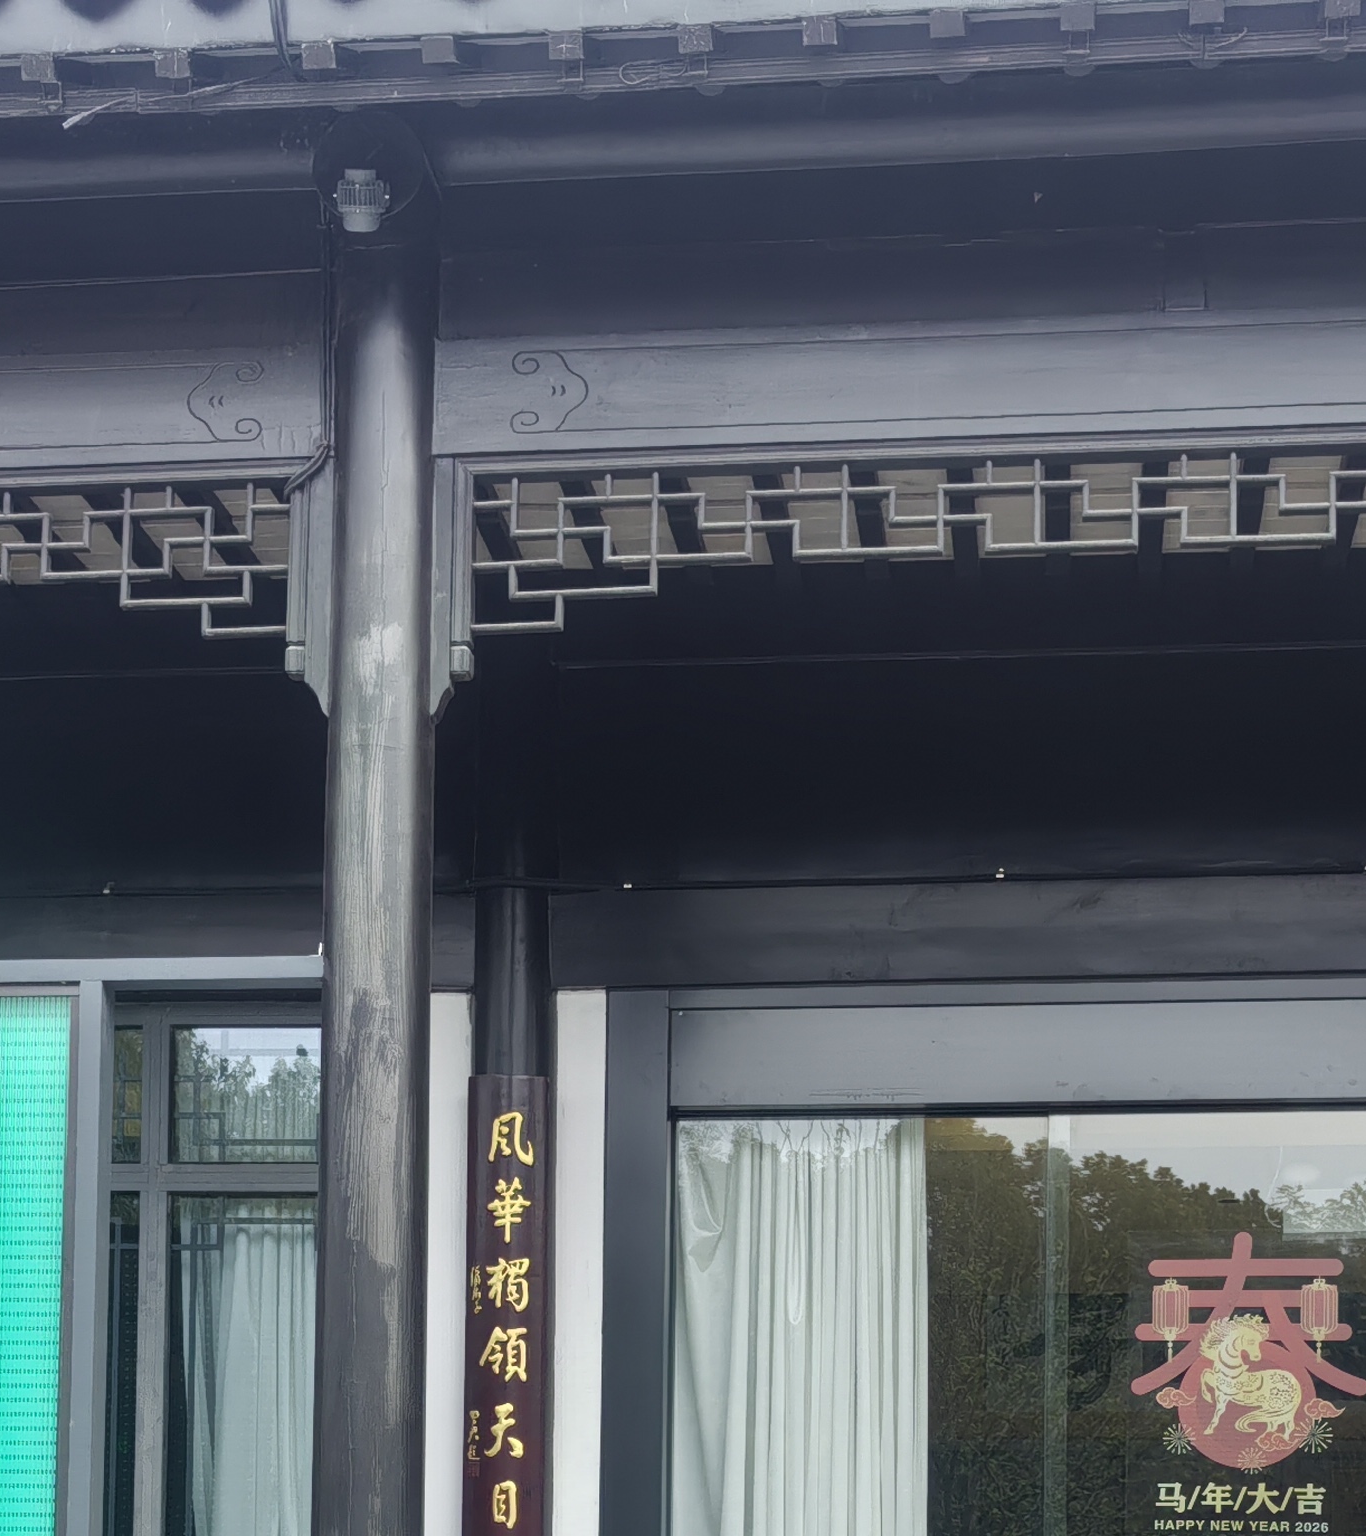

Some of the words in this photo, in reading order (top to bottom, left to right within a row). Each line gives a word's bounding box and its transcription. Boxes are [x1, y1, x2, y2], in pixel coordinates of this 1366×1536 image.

[1154, 1519, 1205, 1531] HAPPY
[1210, 1519, 1244, 1532] NEW
[1249, 1520, 1290, 1533] YEAR
[1295, 1521, 1329, 1533] 2026
